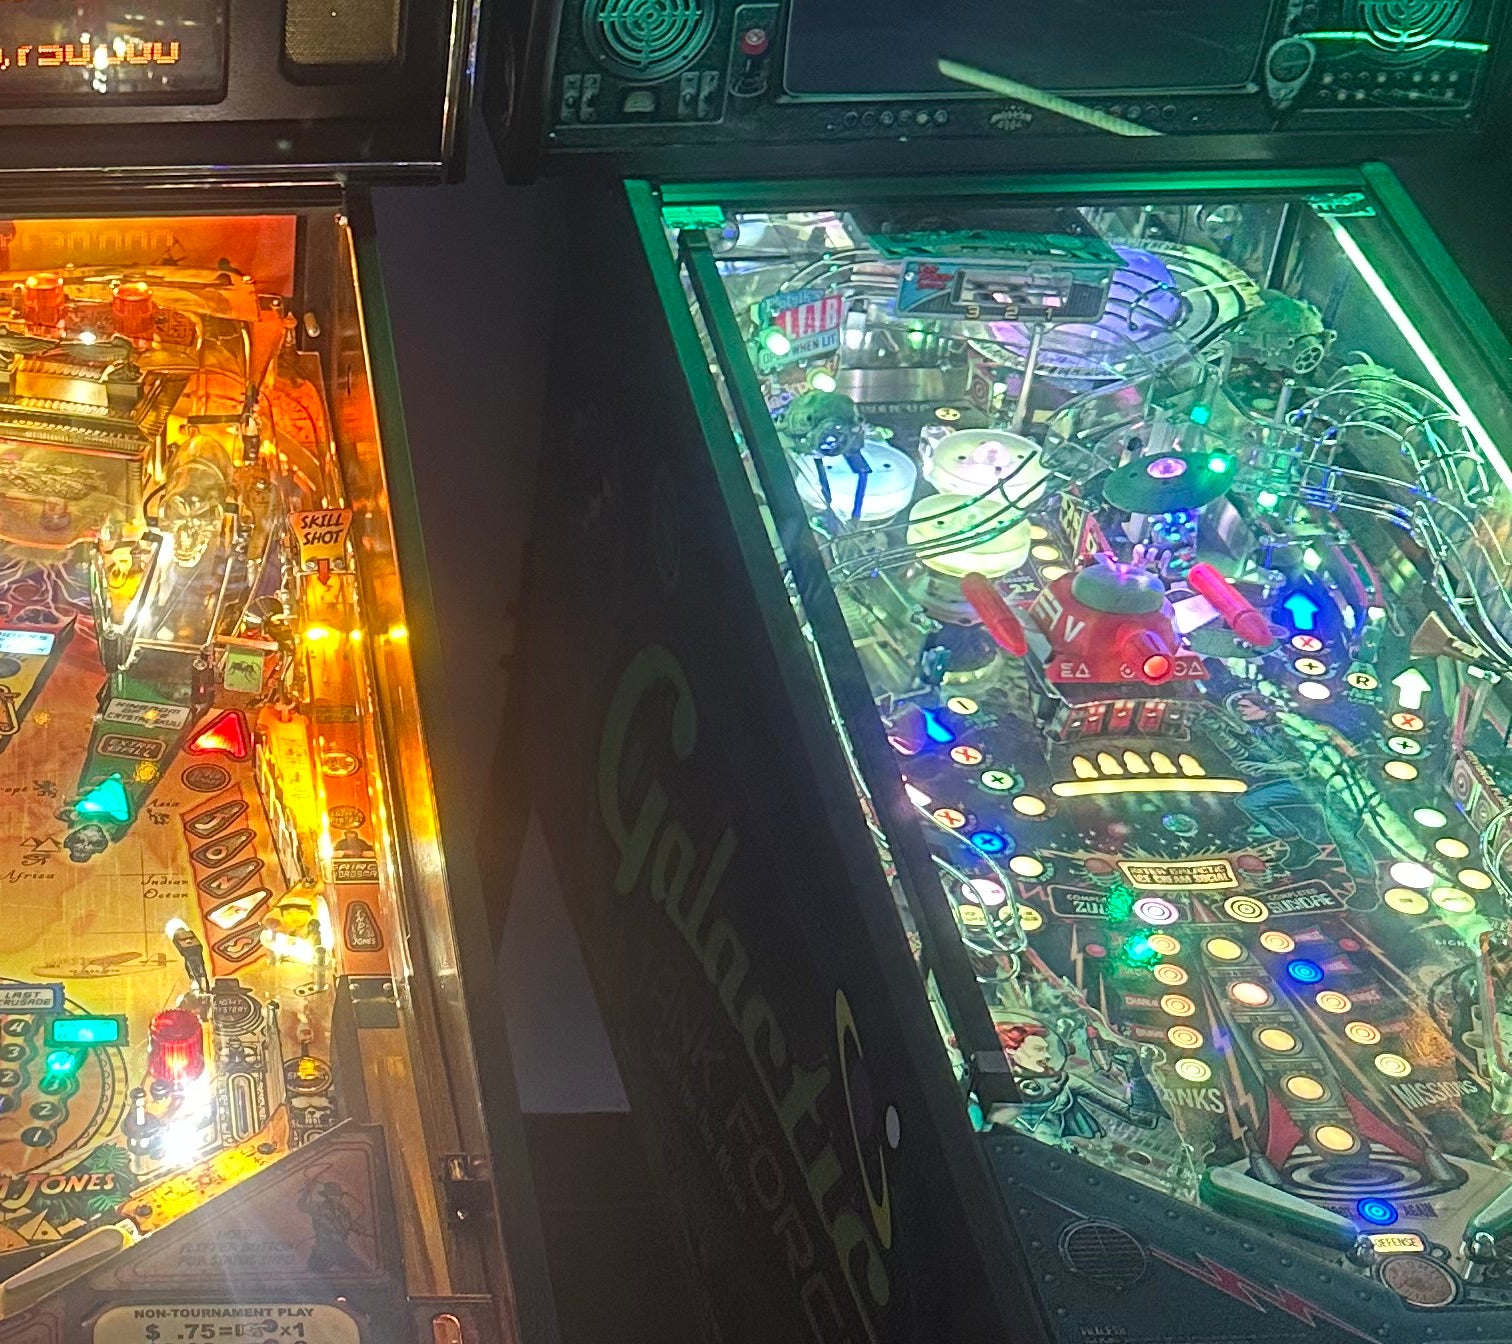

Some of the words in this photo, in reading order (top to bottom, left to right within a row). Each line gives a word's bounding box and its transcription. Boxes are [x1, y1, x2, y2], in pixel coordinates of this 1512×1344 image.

[792, 339, 819, 356] WHEN
[822, 335, 836, 347] LIT
[299, 513, 345, 528] SKILL
[302, 529, 344, 545] SHOT
[107, 737, 157, 749] EXTRA
[107, 745, 152, 758] BALL
[4, 991, 41, 1000] LAST
[1390, 1080, 1480, 1110] MISSIONS
[3, 1171, 115, 1213] JONES
[134, 1308, 274, 1319] NON-TOURNAMENT
[277, 1307, 314, 1317] PLAY
